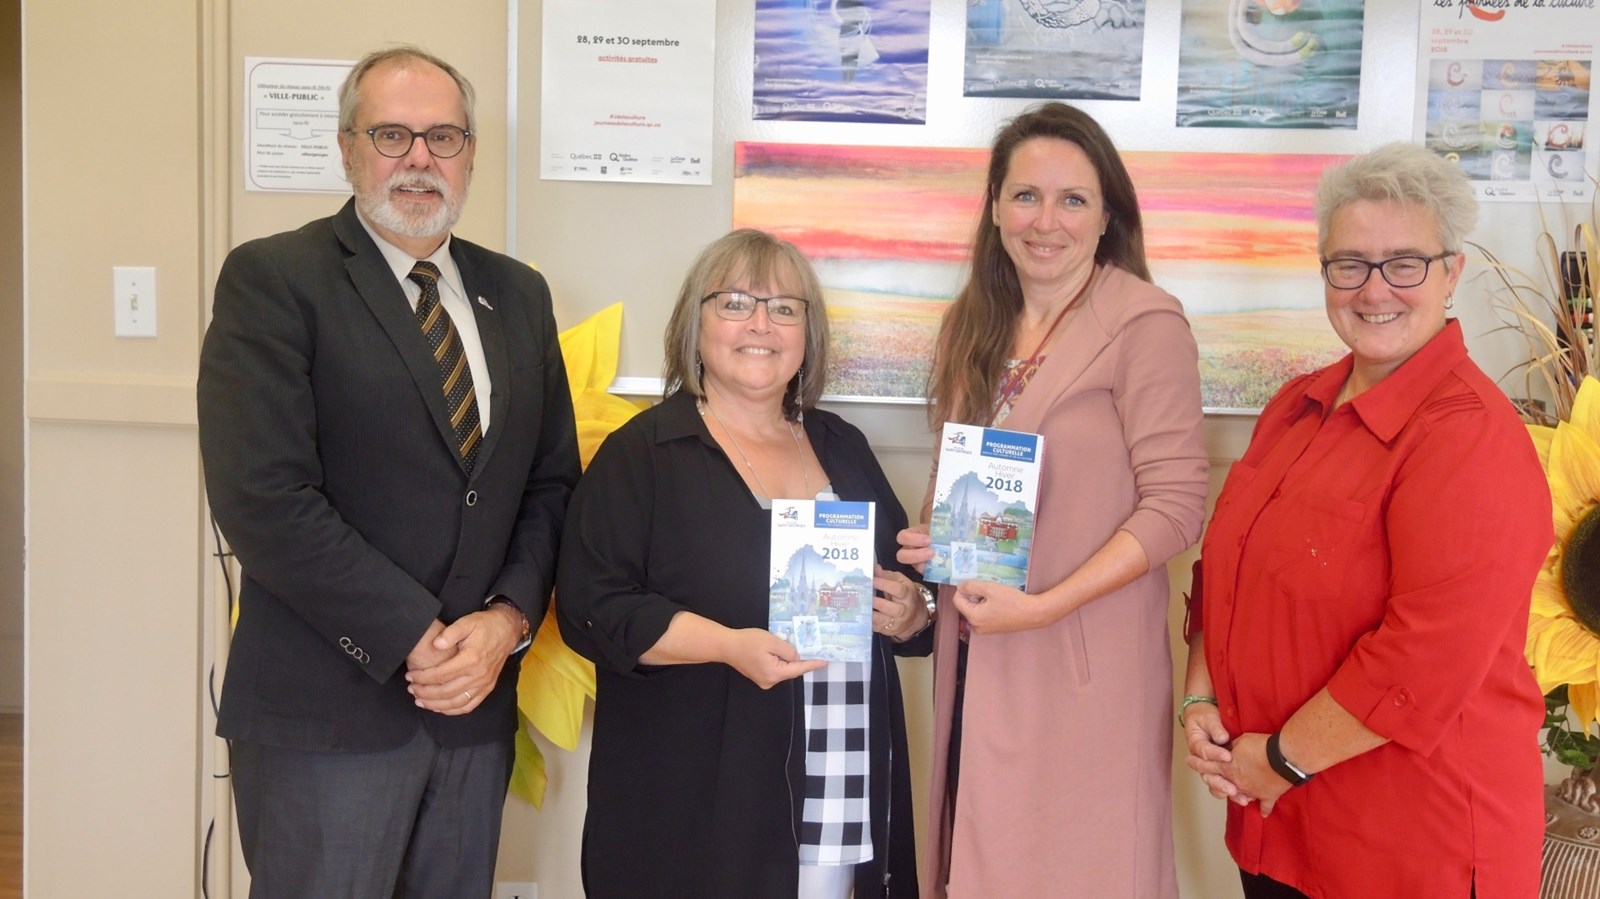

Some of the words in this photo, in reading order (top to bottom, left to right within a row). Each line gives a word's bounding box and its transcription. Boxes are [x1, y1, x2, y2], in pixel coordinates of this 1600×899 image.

[577, 35, 591, 45] 28,
[593, 36, 604, 44] 29
[605, 37, 615, 45] et
[617, 37, 630, 45] 30
[632, 37, 680, 47] septembre
[1431, 38, 1469, 46] septembre
[598, 54, 626, 62] activités
[269, 93, 319, 101] VILLE-PUBLIC
[570, 152, 593, 161] Québec
[986, 441, 1032, 453] PROGRAMMATION
[992, 448, 1024, 457] CULTURELLE
[988, 462, 1024, 474] Automne
[995, 471, 1015, 479] Hiver
[986, 476, 1023, 493] 2018
[822, 547, 859, 561] 2018
